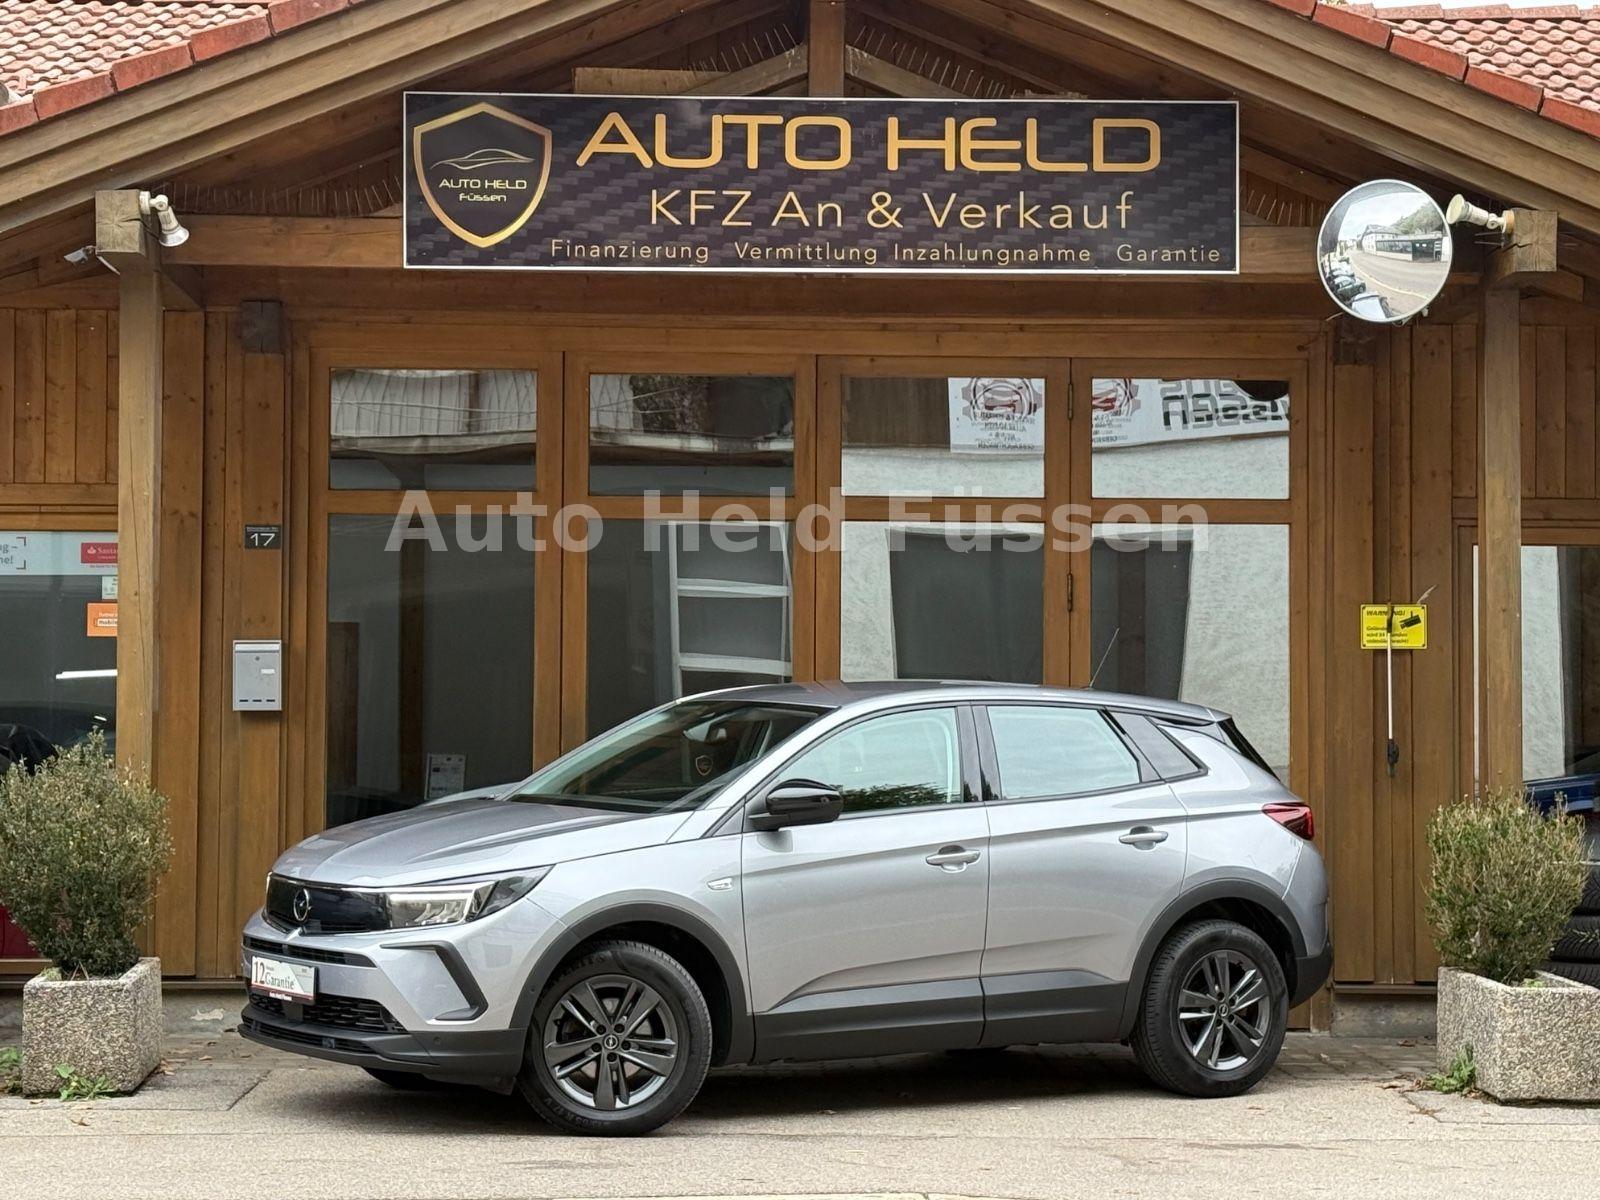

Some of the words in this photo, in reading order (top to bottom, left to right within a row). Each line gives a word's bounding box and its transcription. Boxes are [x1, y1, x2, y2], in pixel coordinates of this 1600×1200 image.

[576, 111, 852, 170] AUTO
[886, 116, 1161, 172] HELD
[439, 178, 481, 189] AUTO
[485, 179, 527, 190] HELD
[650, 188, 752, 226] KFZ
[771, 191, 843, 228] An
[866, 190, 903, 229] &
[922, 190, 1134, 230] Verkauf
[551, 239, 709, 264] Finanzierung
[735, 241, 878, 265] Vermittlung
[894, 243, 1091, 266] Inzahlungnahme
[1116, 244, 1221, 263] Garantie
[250, 533, 276, 546] 17
[265, 972, 295, 990] Garantie
